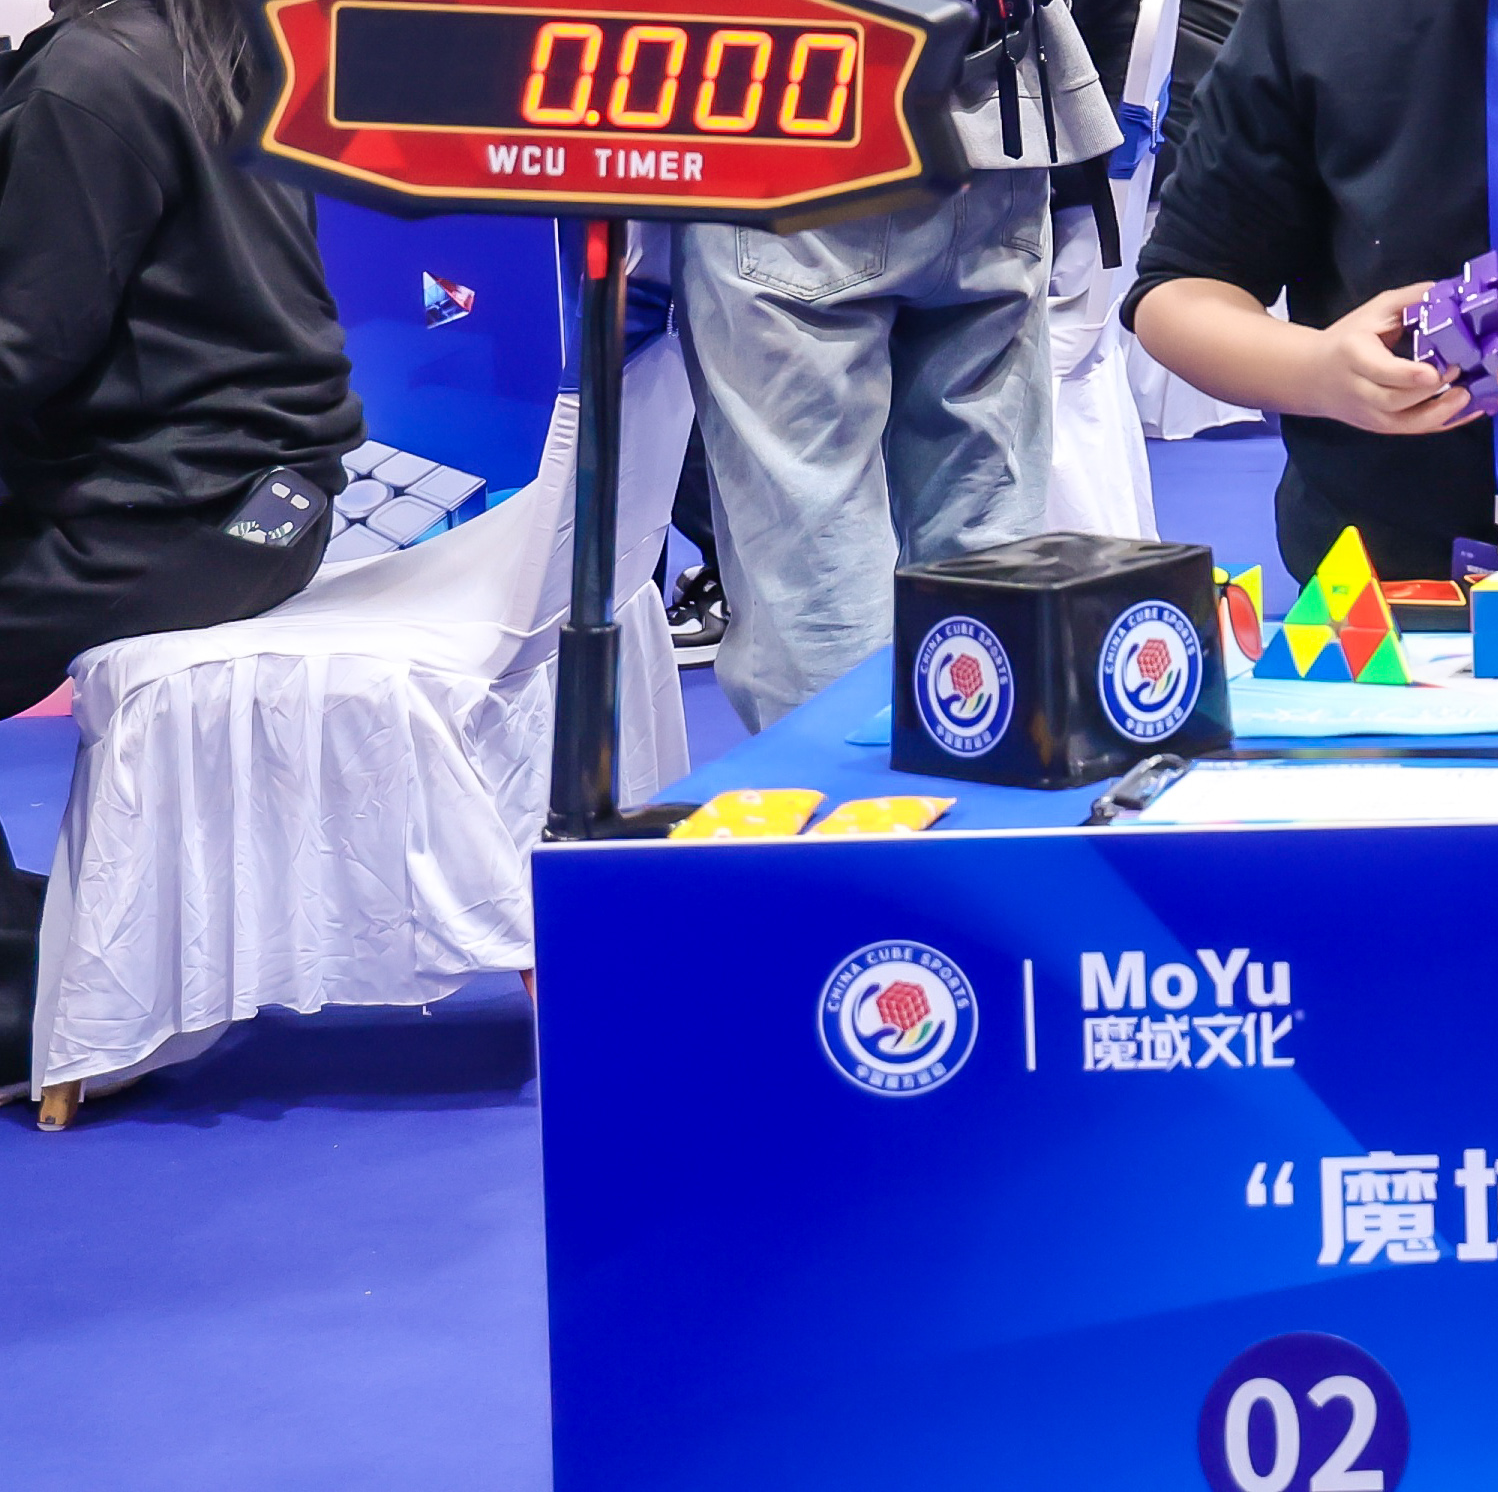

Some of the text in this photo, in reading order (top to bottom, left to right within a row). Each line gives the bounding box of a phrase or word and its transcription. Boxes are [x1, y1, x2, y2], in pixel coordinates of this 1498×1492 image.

[521, 19, 859, 138] 0.000
[487, 144, 705, 182] WCU TIMER
[827, 946, 971, 1013] CHINA CUBE SPORTS
[1081, 948, 1292, 1011] MoYu
[1083, 1011, 1296, 1072] 魔域文化
[1224, 1375, 1384, 1492] 02
